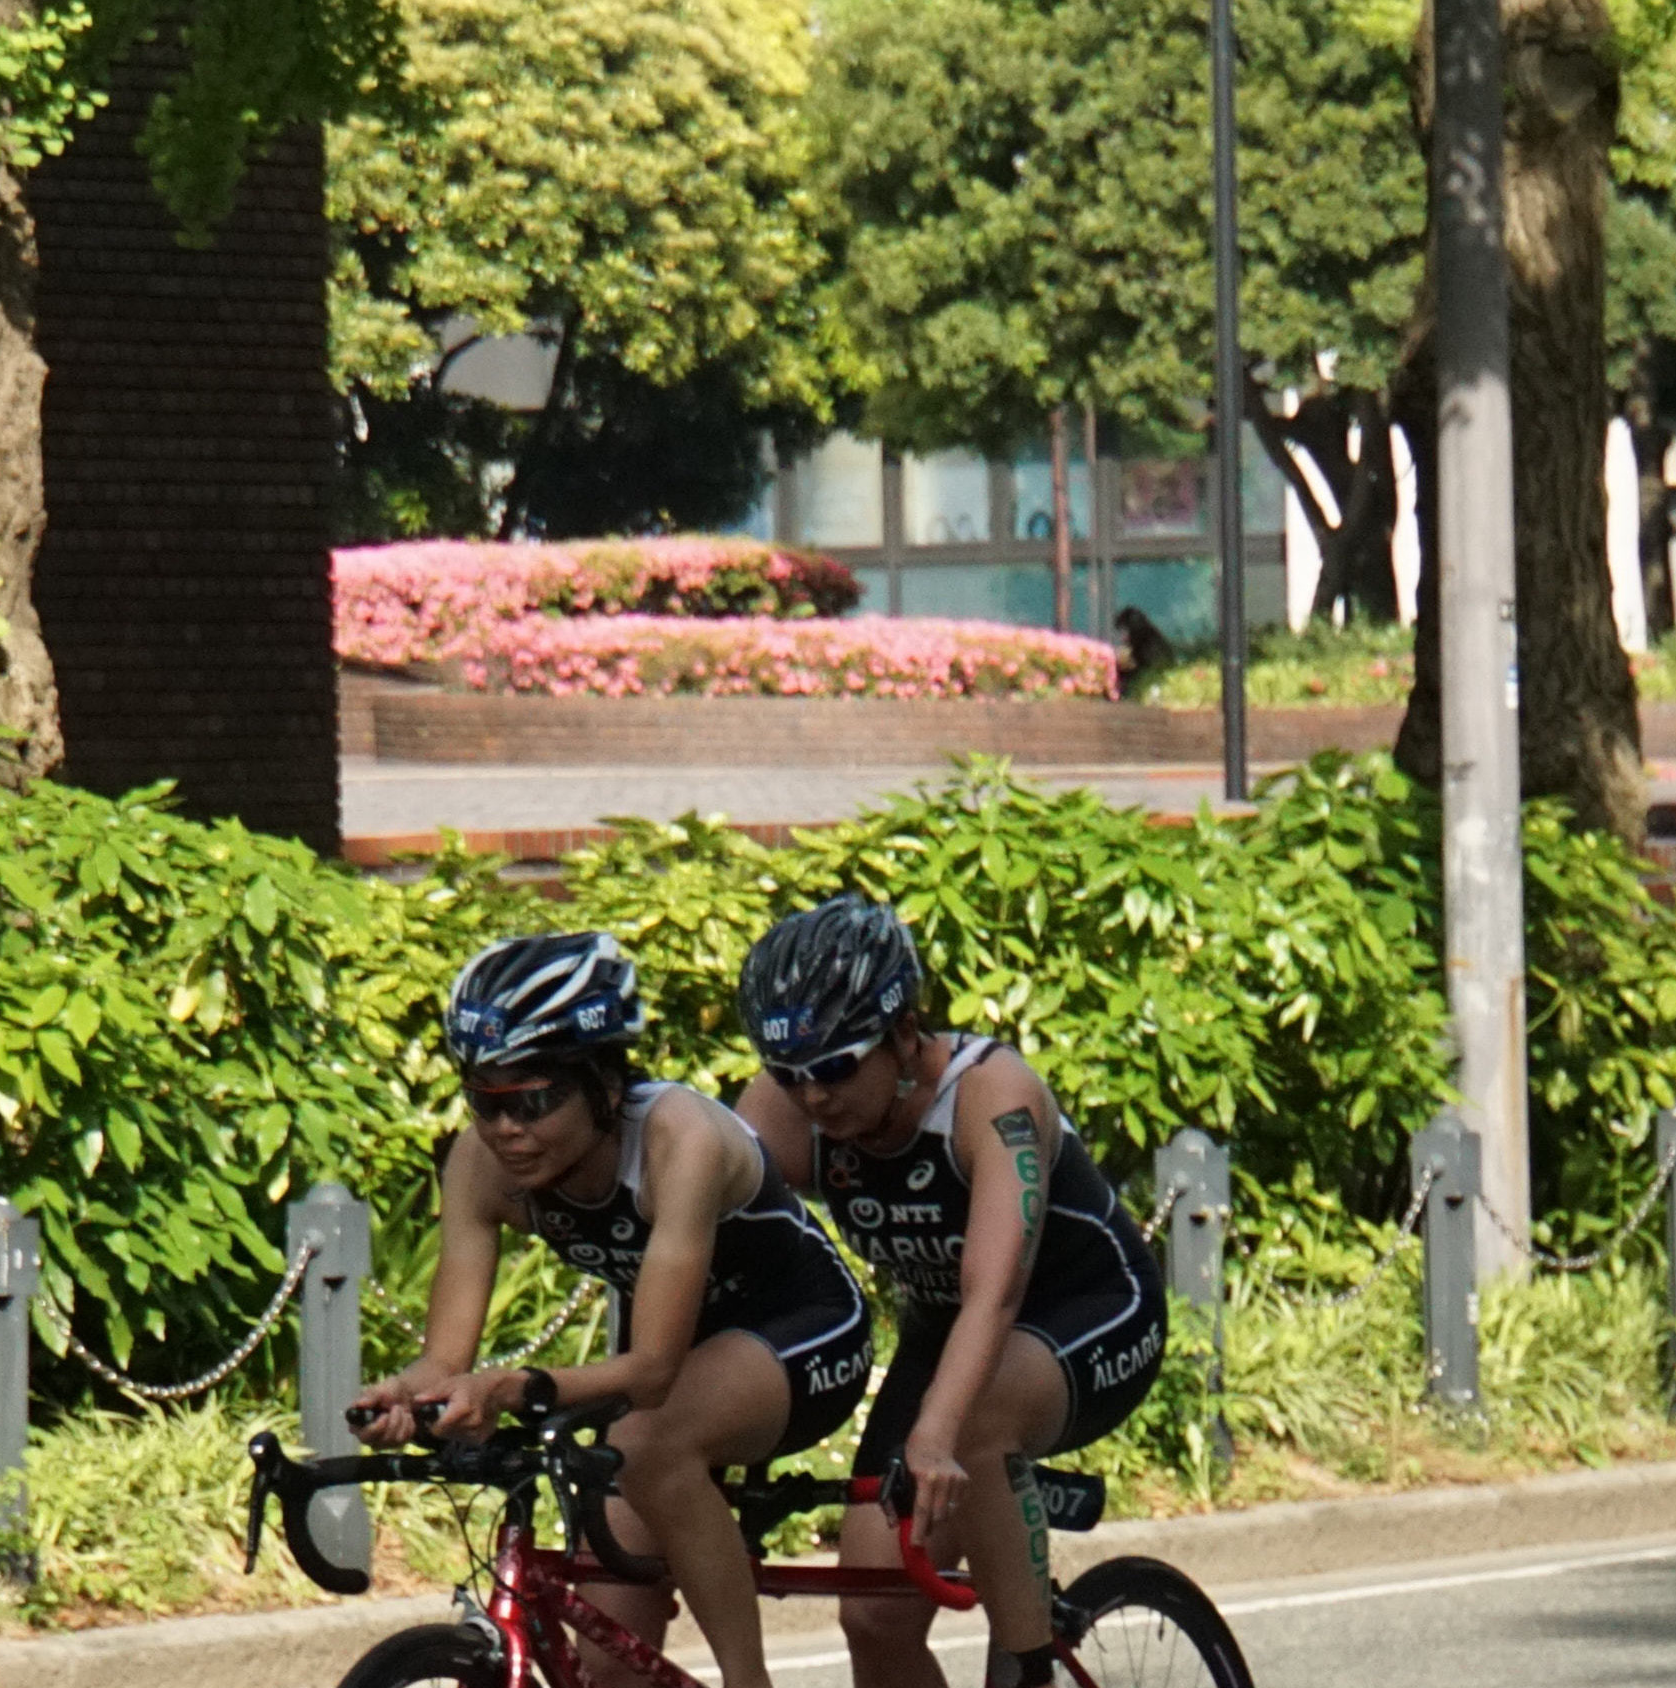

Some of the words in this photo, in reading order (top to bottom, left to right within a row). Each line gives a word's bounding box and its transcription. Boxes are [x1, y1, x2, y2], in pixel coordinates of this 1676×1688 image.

[880, 981, 904, 1013] 607
[576, 1004, 606, 1031] 607
[889, 1203, 942, 1223] NTT
[1090, 1321, 1162, 1391] ALCARE
